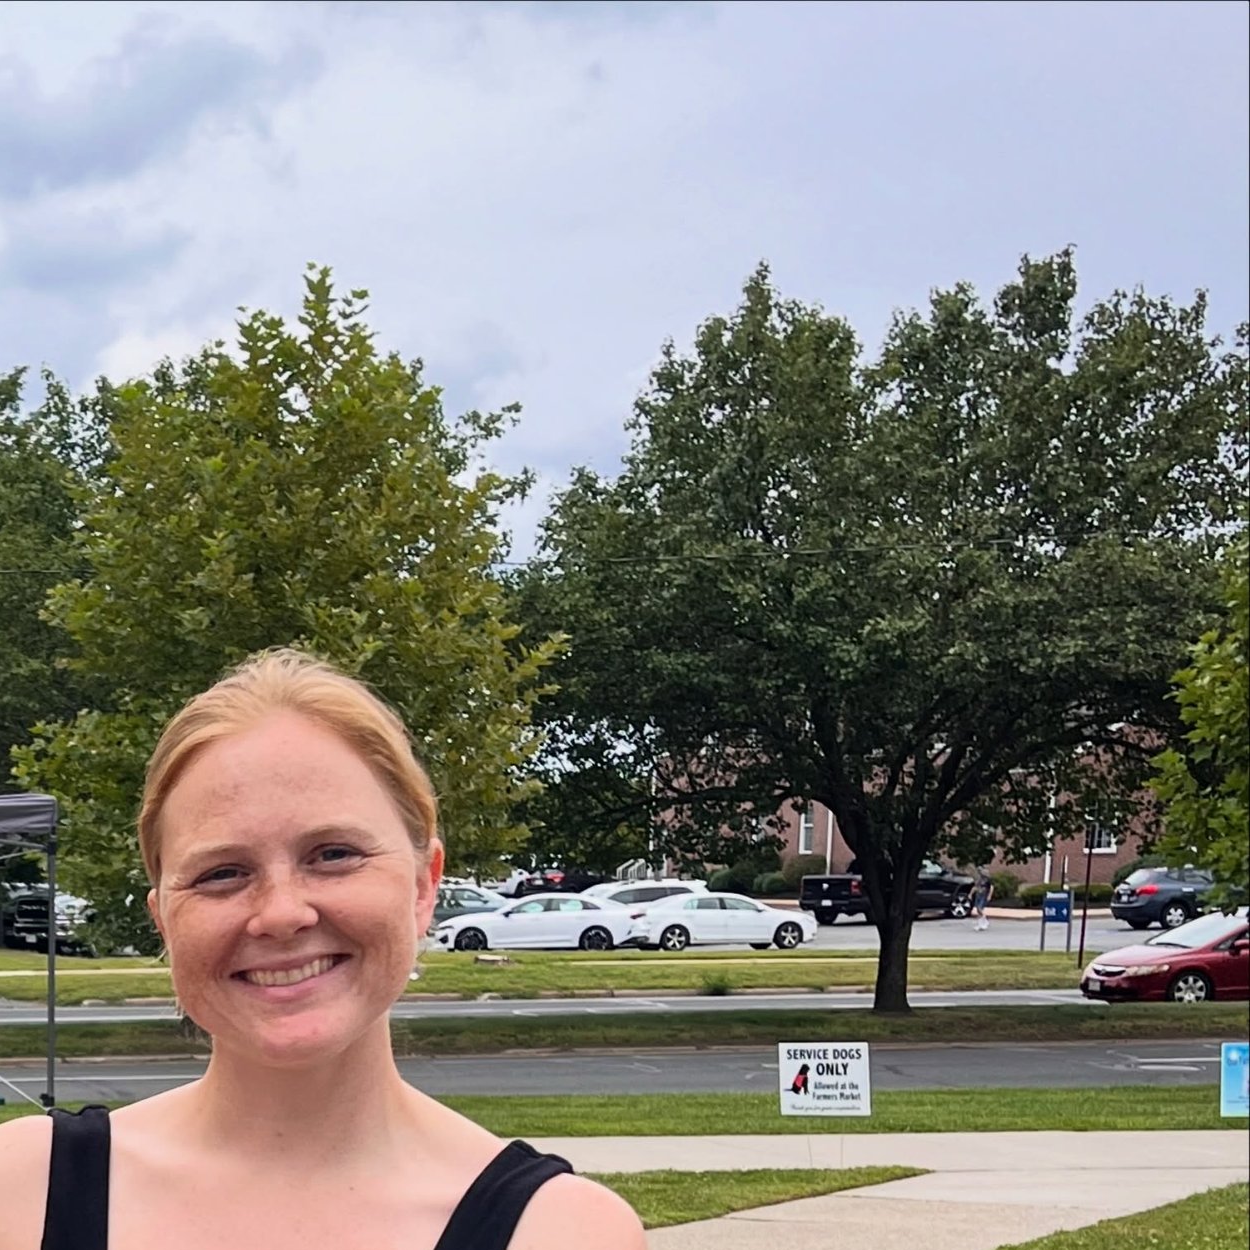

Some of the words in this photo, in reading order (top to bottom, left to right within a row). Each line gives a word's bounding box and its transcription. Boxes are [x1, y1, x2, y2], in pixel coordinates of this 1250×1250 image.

[786, 1048, 829, 1060] SERVICE
[832, 1048, 862, 1060] DOGS
[815, 1062, 849, 1076] ONLY
[814, 1081, 839, 1091] Allowed
[840, 1082, 847, 1090] at
[848, 1081, 859, 1090] the
[812, 1092, 838, 1101] Farmers
[839, 1092, 861, 1101] Market
